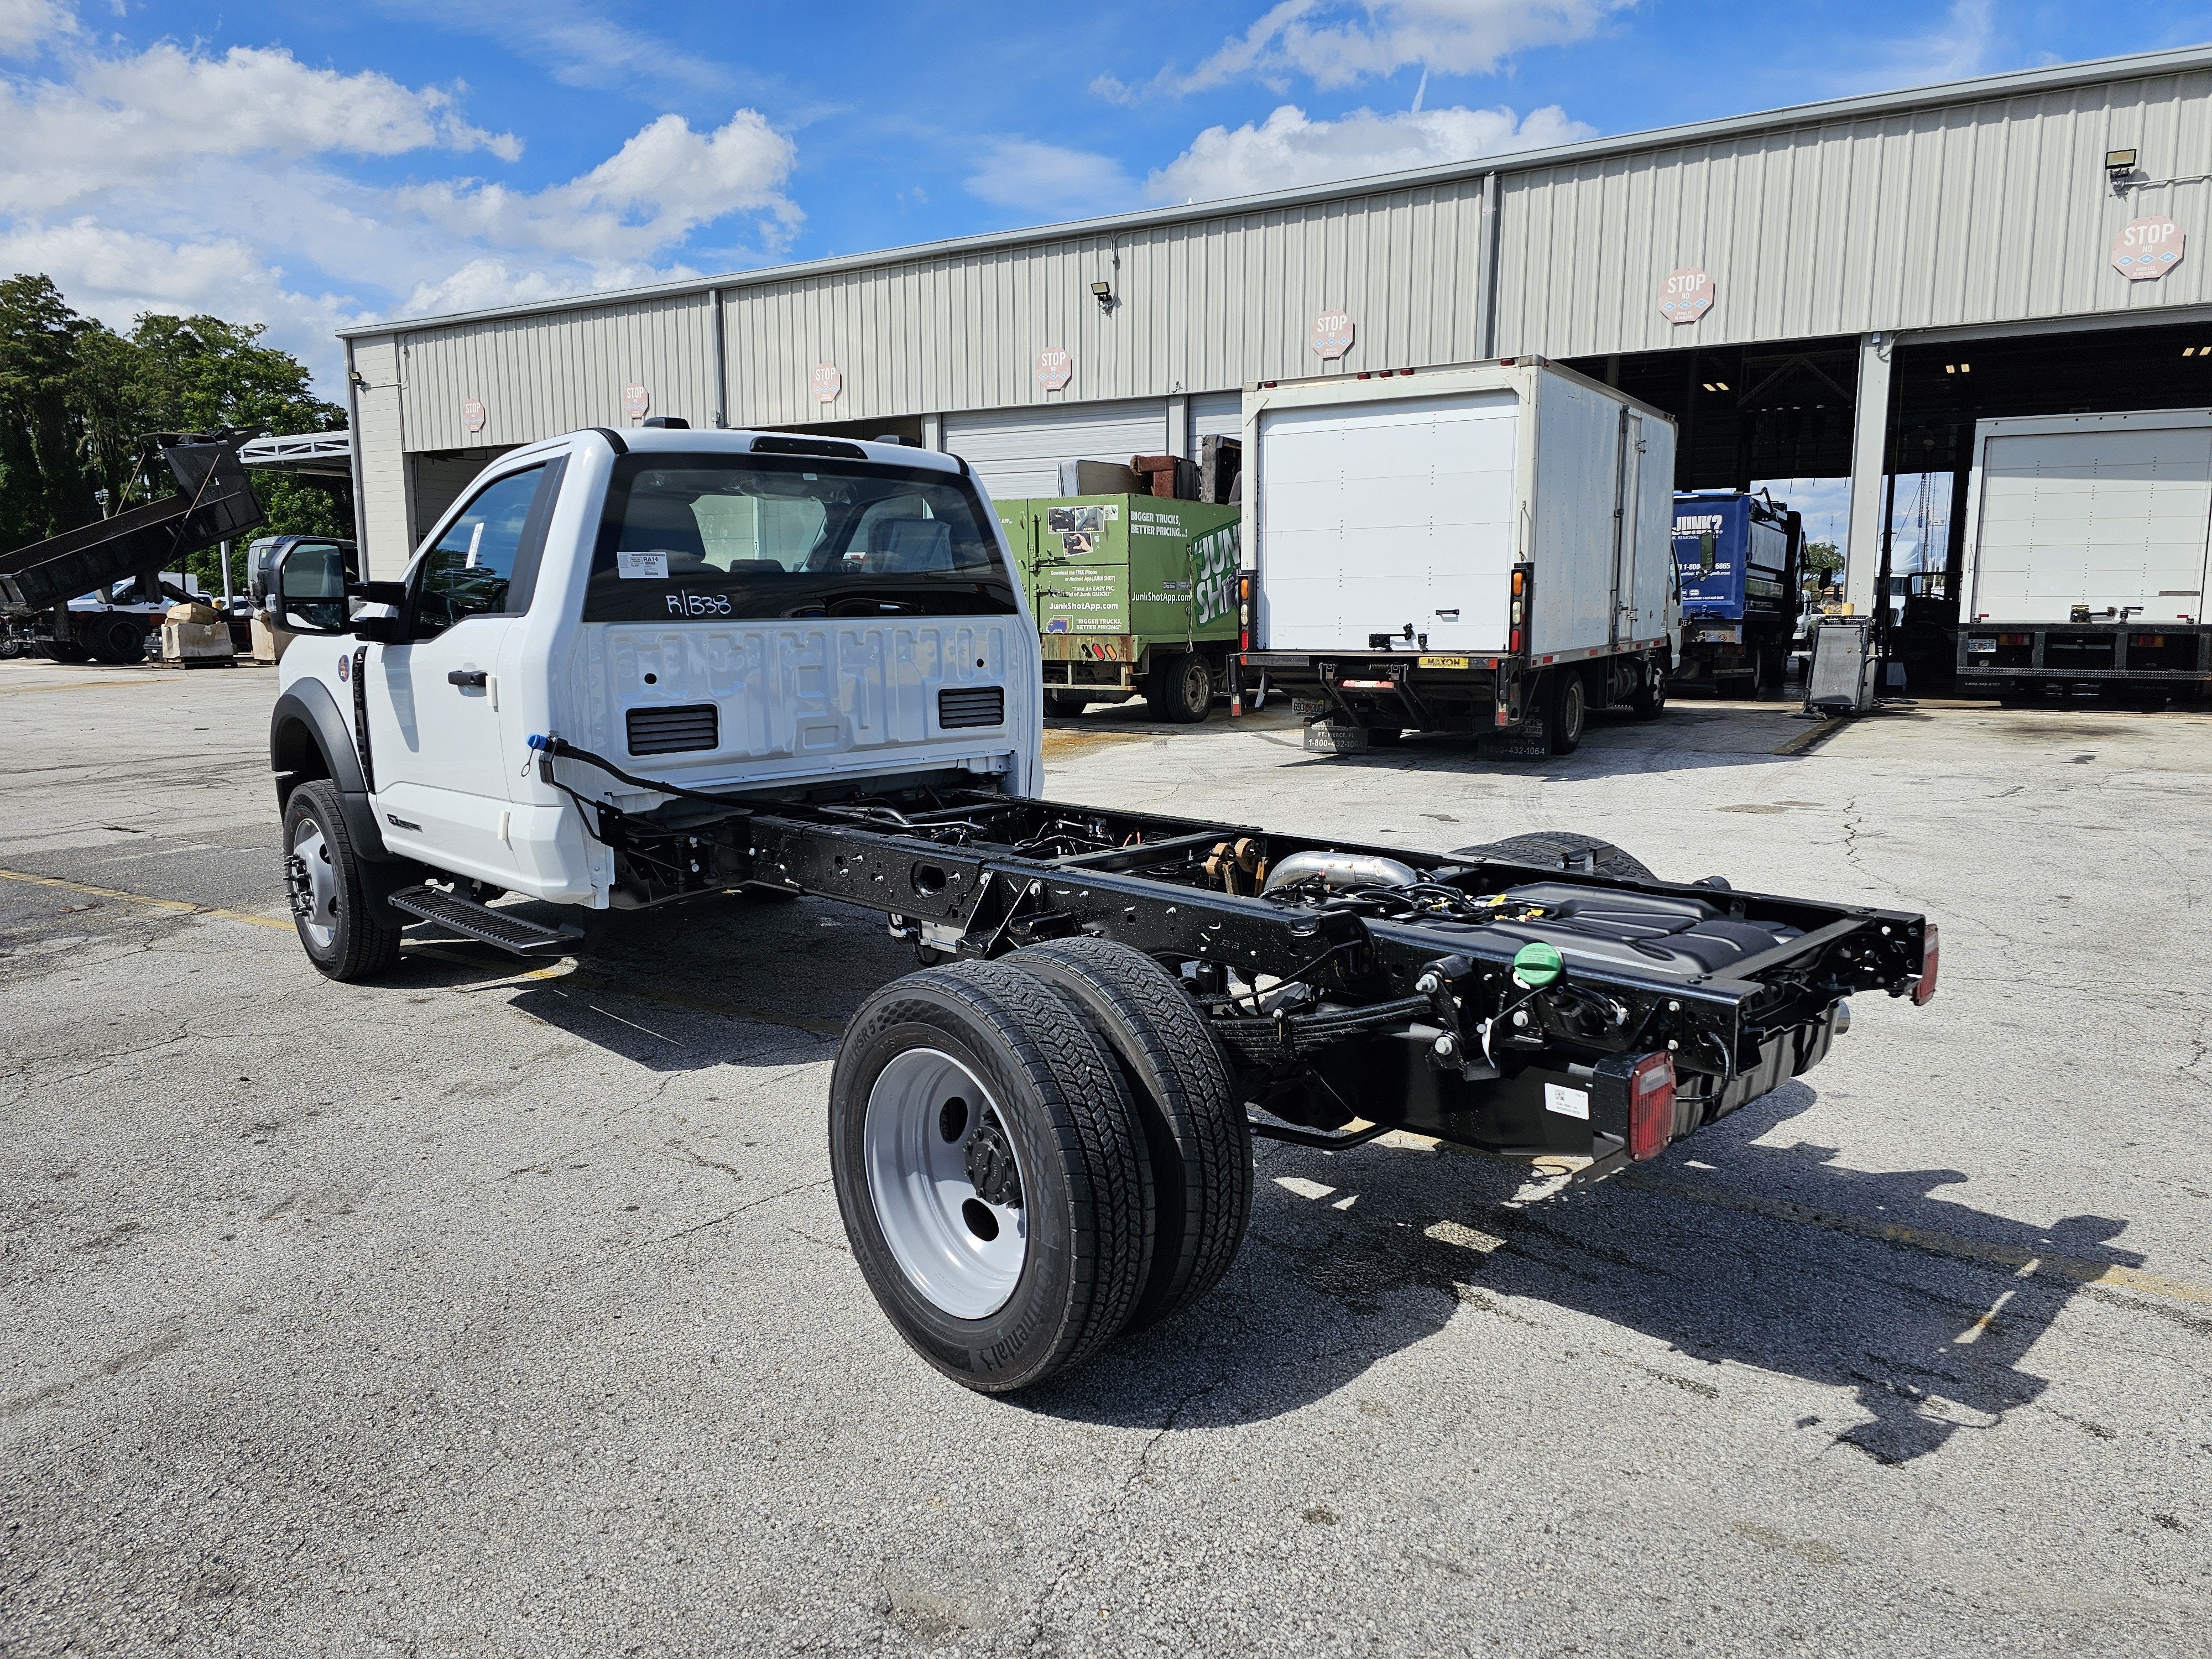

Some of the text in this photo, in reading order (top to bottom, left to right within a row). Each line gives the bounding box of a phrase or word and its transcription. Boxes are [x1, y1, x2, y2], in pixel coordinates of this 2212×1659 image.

[2124, 223, 2174, 246] STOP
[1667, 274, 1706, 294] STOP
[1317, 315, 1347, 332] STOP
[1041, 352, 1066, 367] STOP
[816, 367, 836, 381] STOP
[627, 387, 644, 399] STOP
[465, 403, 481, 414] STOP
[1130, 511, 1181, 526] BIGGER TRUCKS,
[1671, 515, 1723, 535] JUNK?
[1130, 524, 1187, 538] BETTER PRICING...!
[1131, 592, 1190, 604] JunkShotApp.com
[1050, 602, 1118, 611] JunkShotApp.com
[1293, 702, 1305, 712] 693
[851, 1026, 870, 1057] HSR
[868, 1018, 876, 1035] 5
